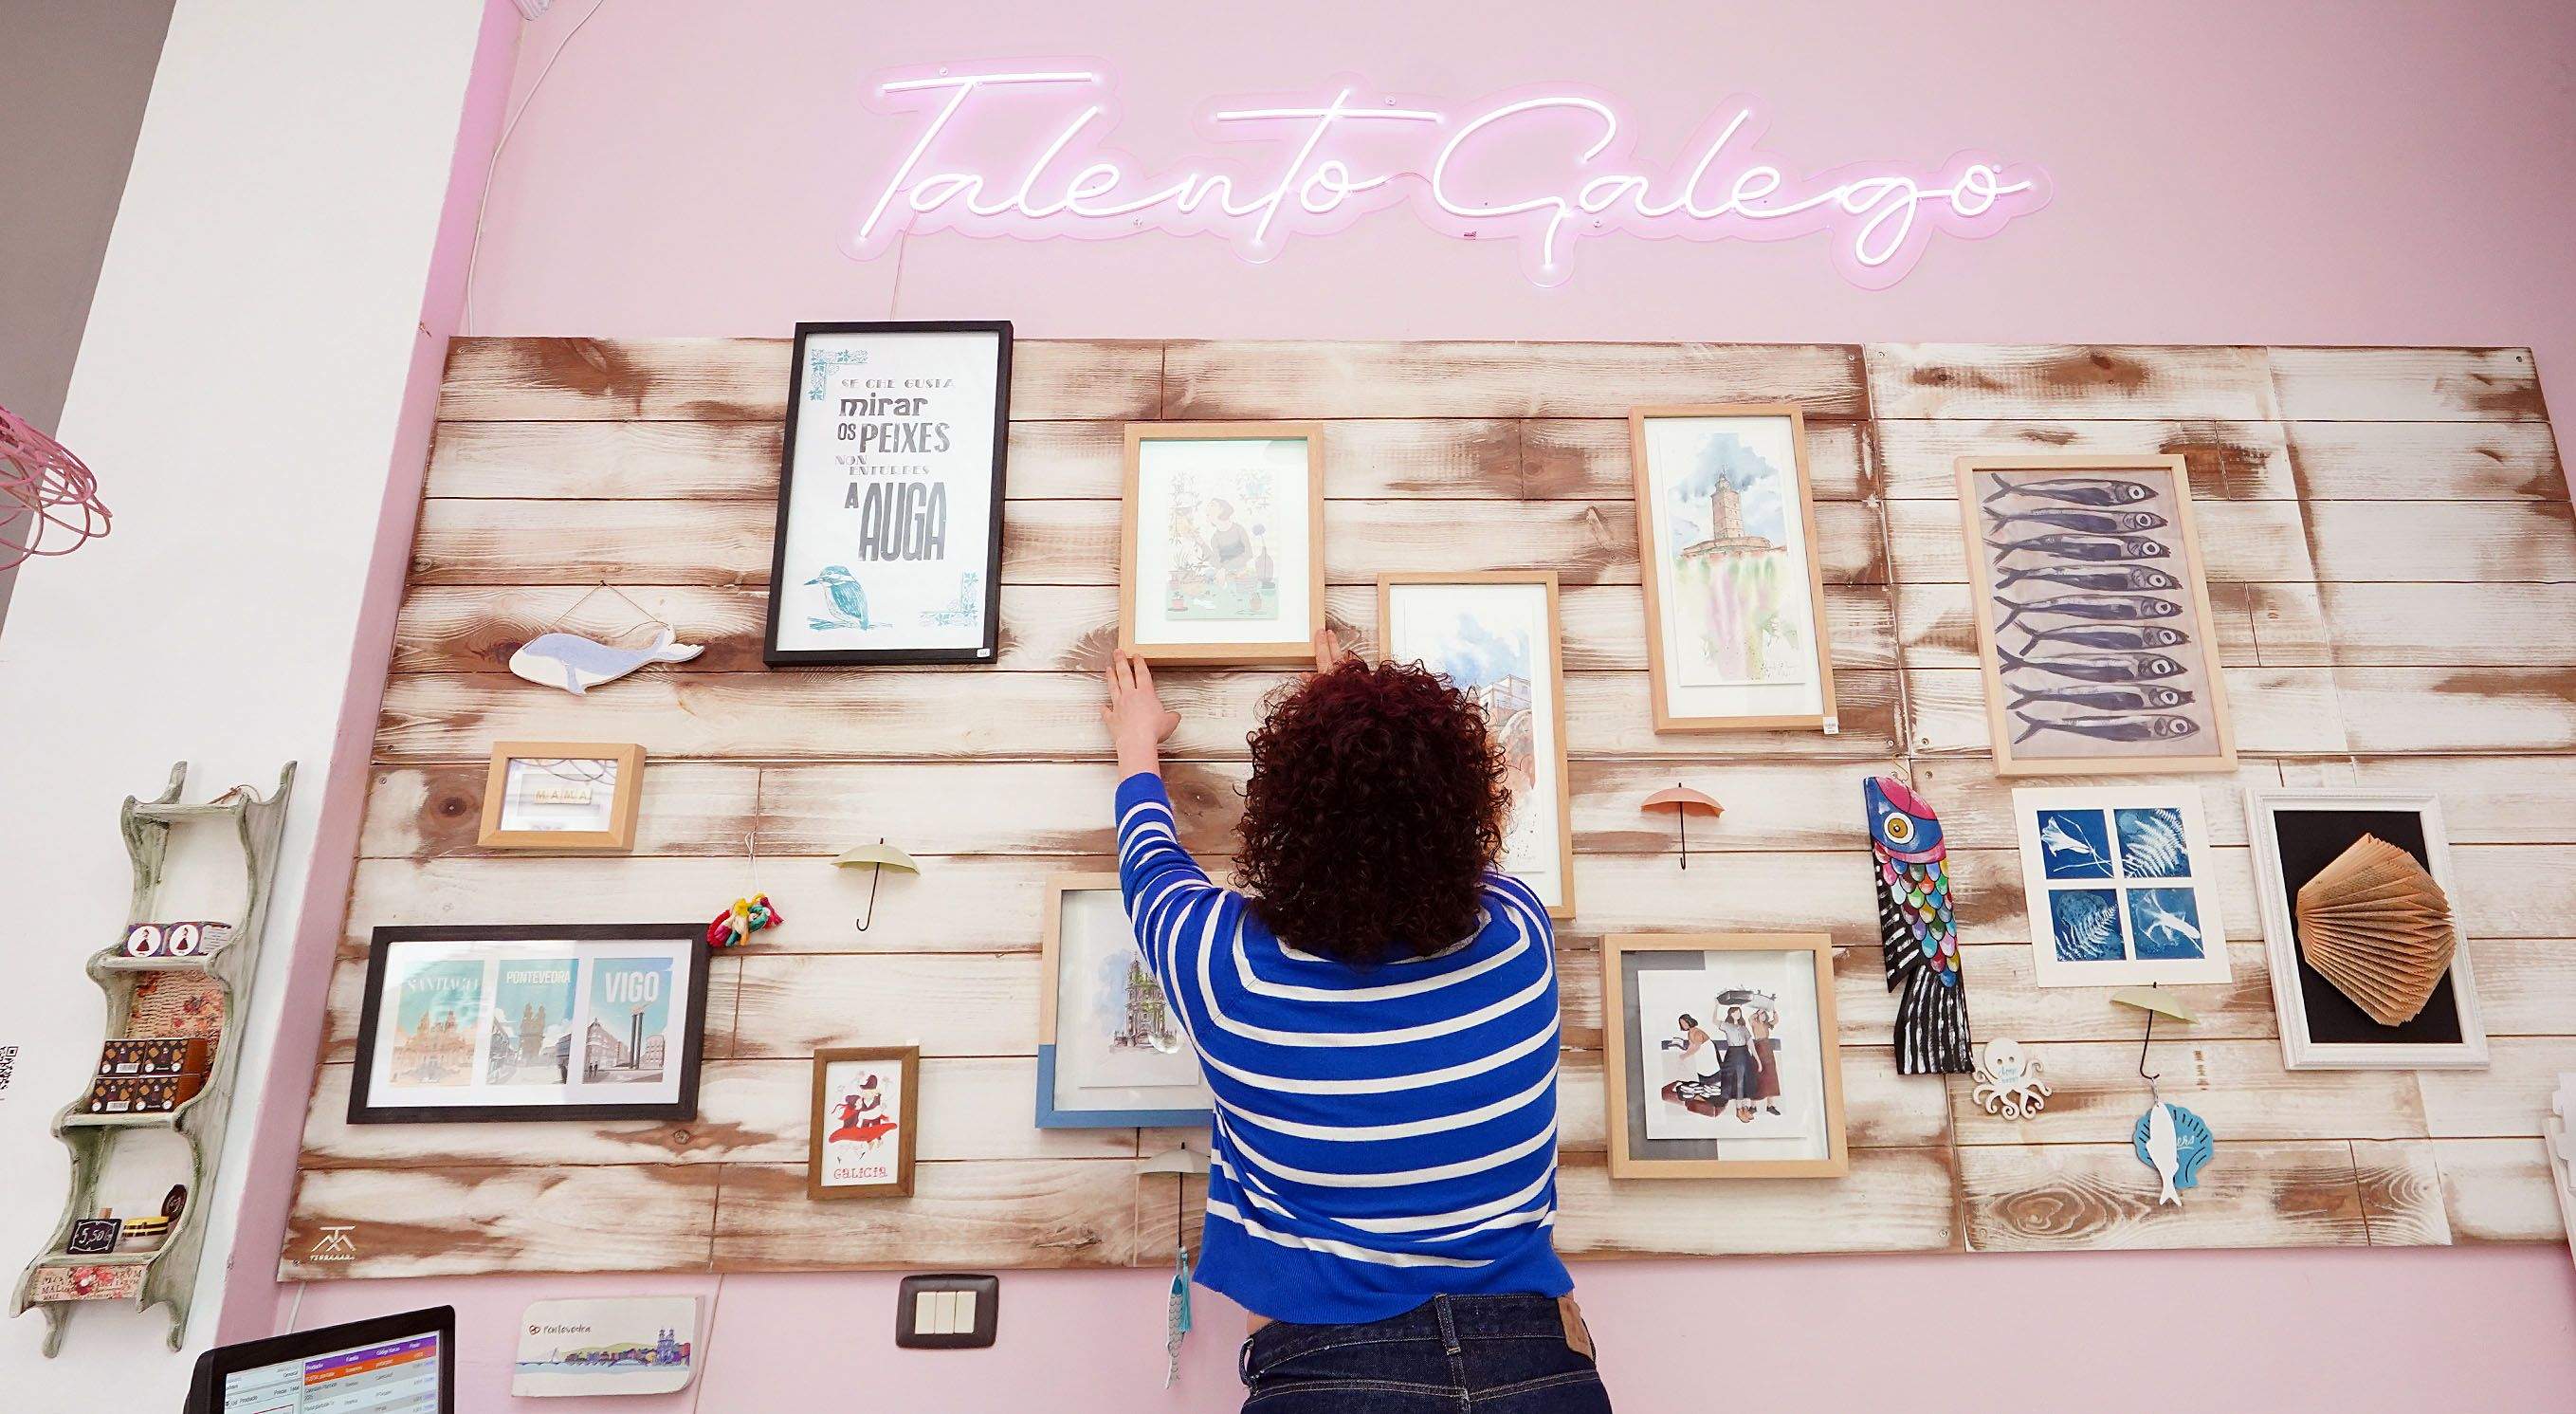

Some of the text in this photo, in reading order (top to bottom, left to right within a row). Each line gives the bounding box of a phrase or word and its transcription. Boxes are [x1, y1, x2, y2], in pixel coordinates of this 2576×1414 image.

[856, 71, 2034, 267] Talento Galego
[865, 378, 896, 389] CHE
[904, 378, 956, 389] GUSTA
[838, 392, 928, 417] mirar
[837, 422, 951, 453] OS PEIXES
[834, 454, 868, 466] NON
[844, 481, 947, 562] A AUGA
[506, 969, 572, 985] PONTEVEDRA
[604, 970, 660, 1003] VIGO
